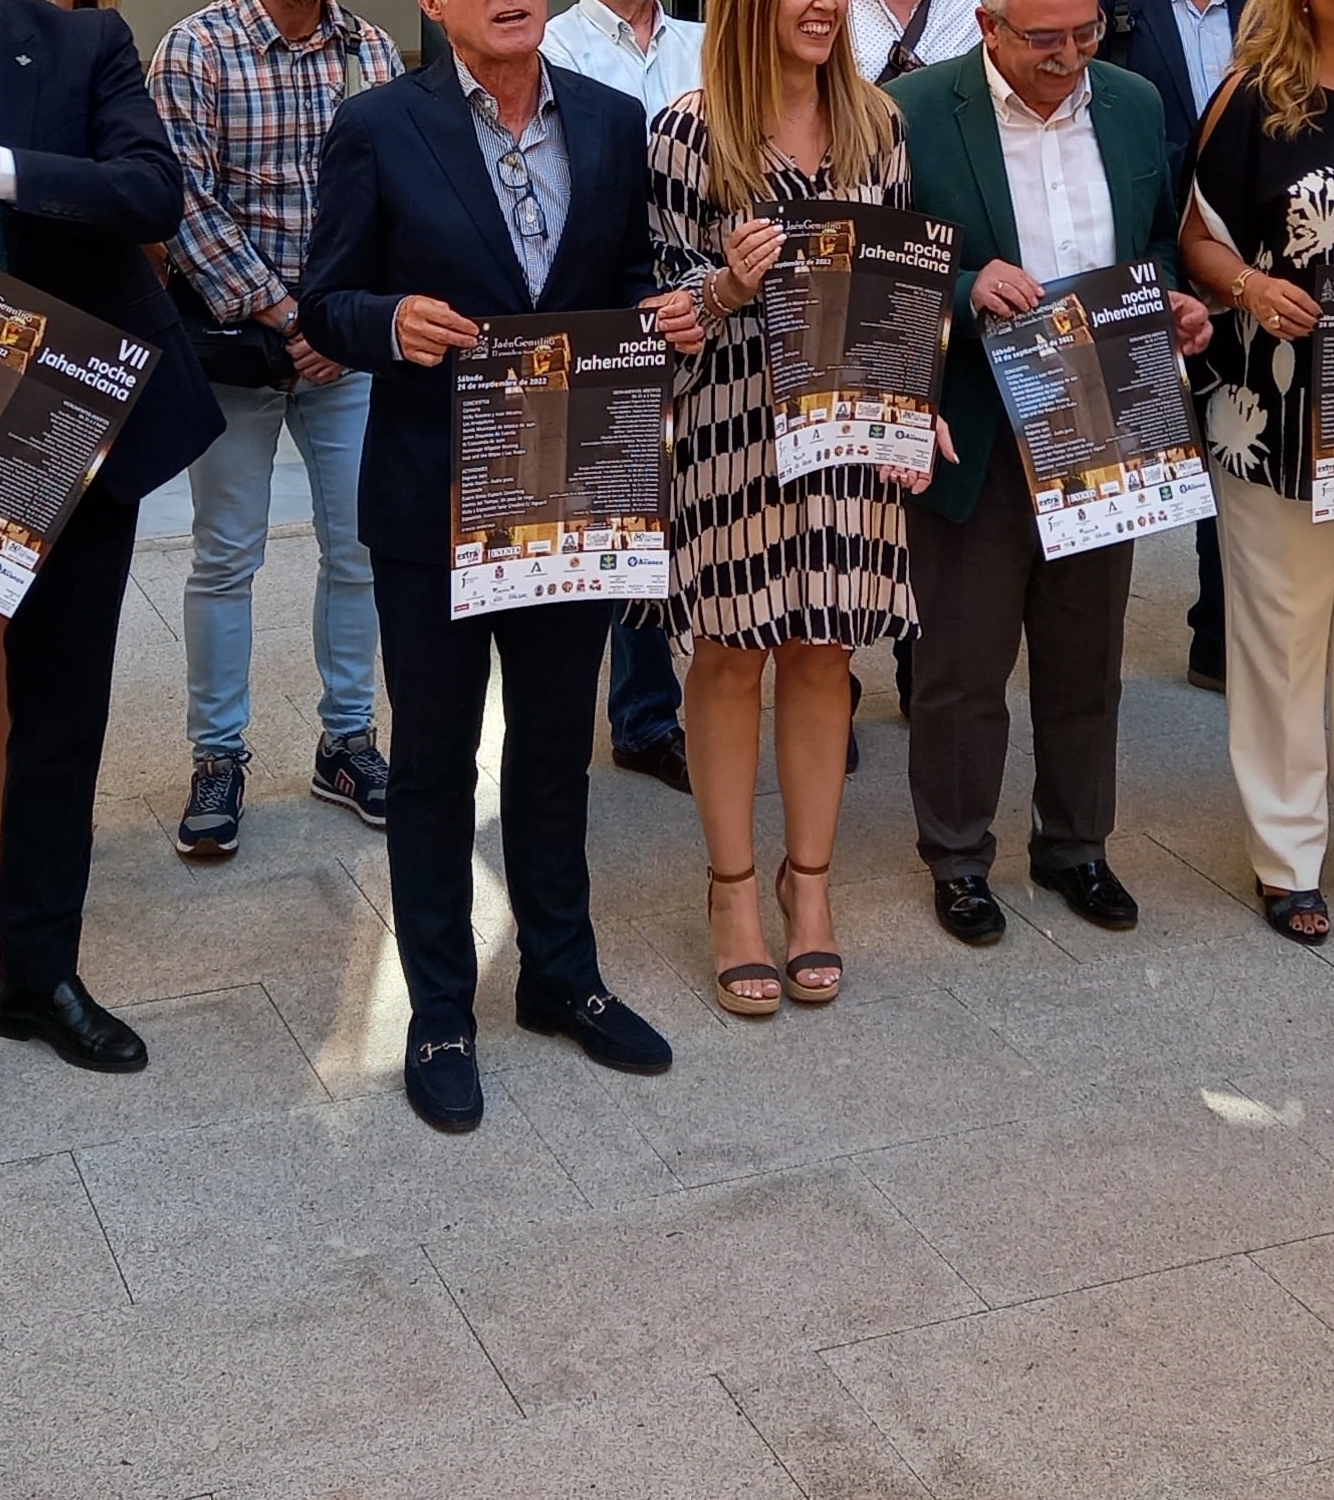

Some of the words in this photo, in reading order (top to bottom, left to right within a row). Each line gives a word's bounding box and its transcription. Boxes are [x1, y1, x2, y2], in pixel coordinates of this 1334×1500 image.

[926, 221, 954, 245] VII
[859, 243, 950, 274] jahenciana
[904, 241, 951, 262] noche
[1129, 262, 1156, 285] VII
[1121, 286, 1161, 305] noche
[1092, 299, 1165, 328] jahenciana
[118, 338, 150, 370] VII
[619, 337, 666, 353] noche
[37, 346, 130, 401] jahenciana
[87, 355, 136, 388] noche
[575, 353, 666, 374] jahenciana
[467, 382, 477, 390] de
[478, 379, 518, 390] septiembre
